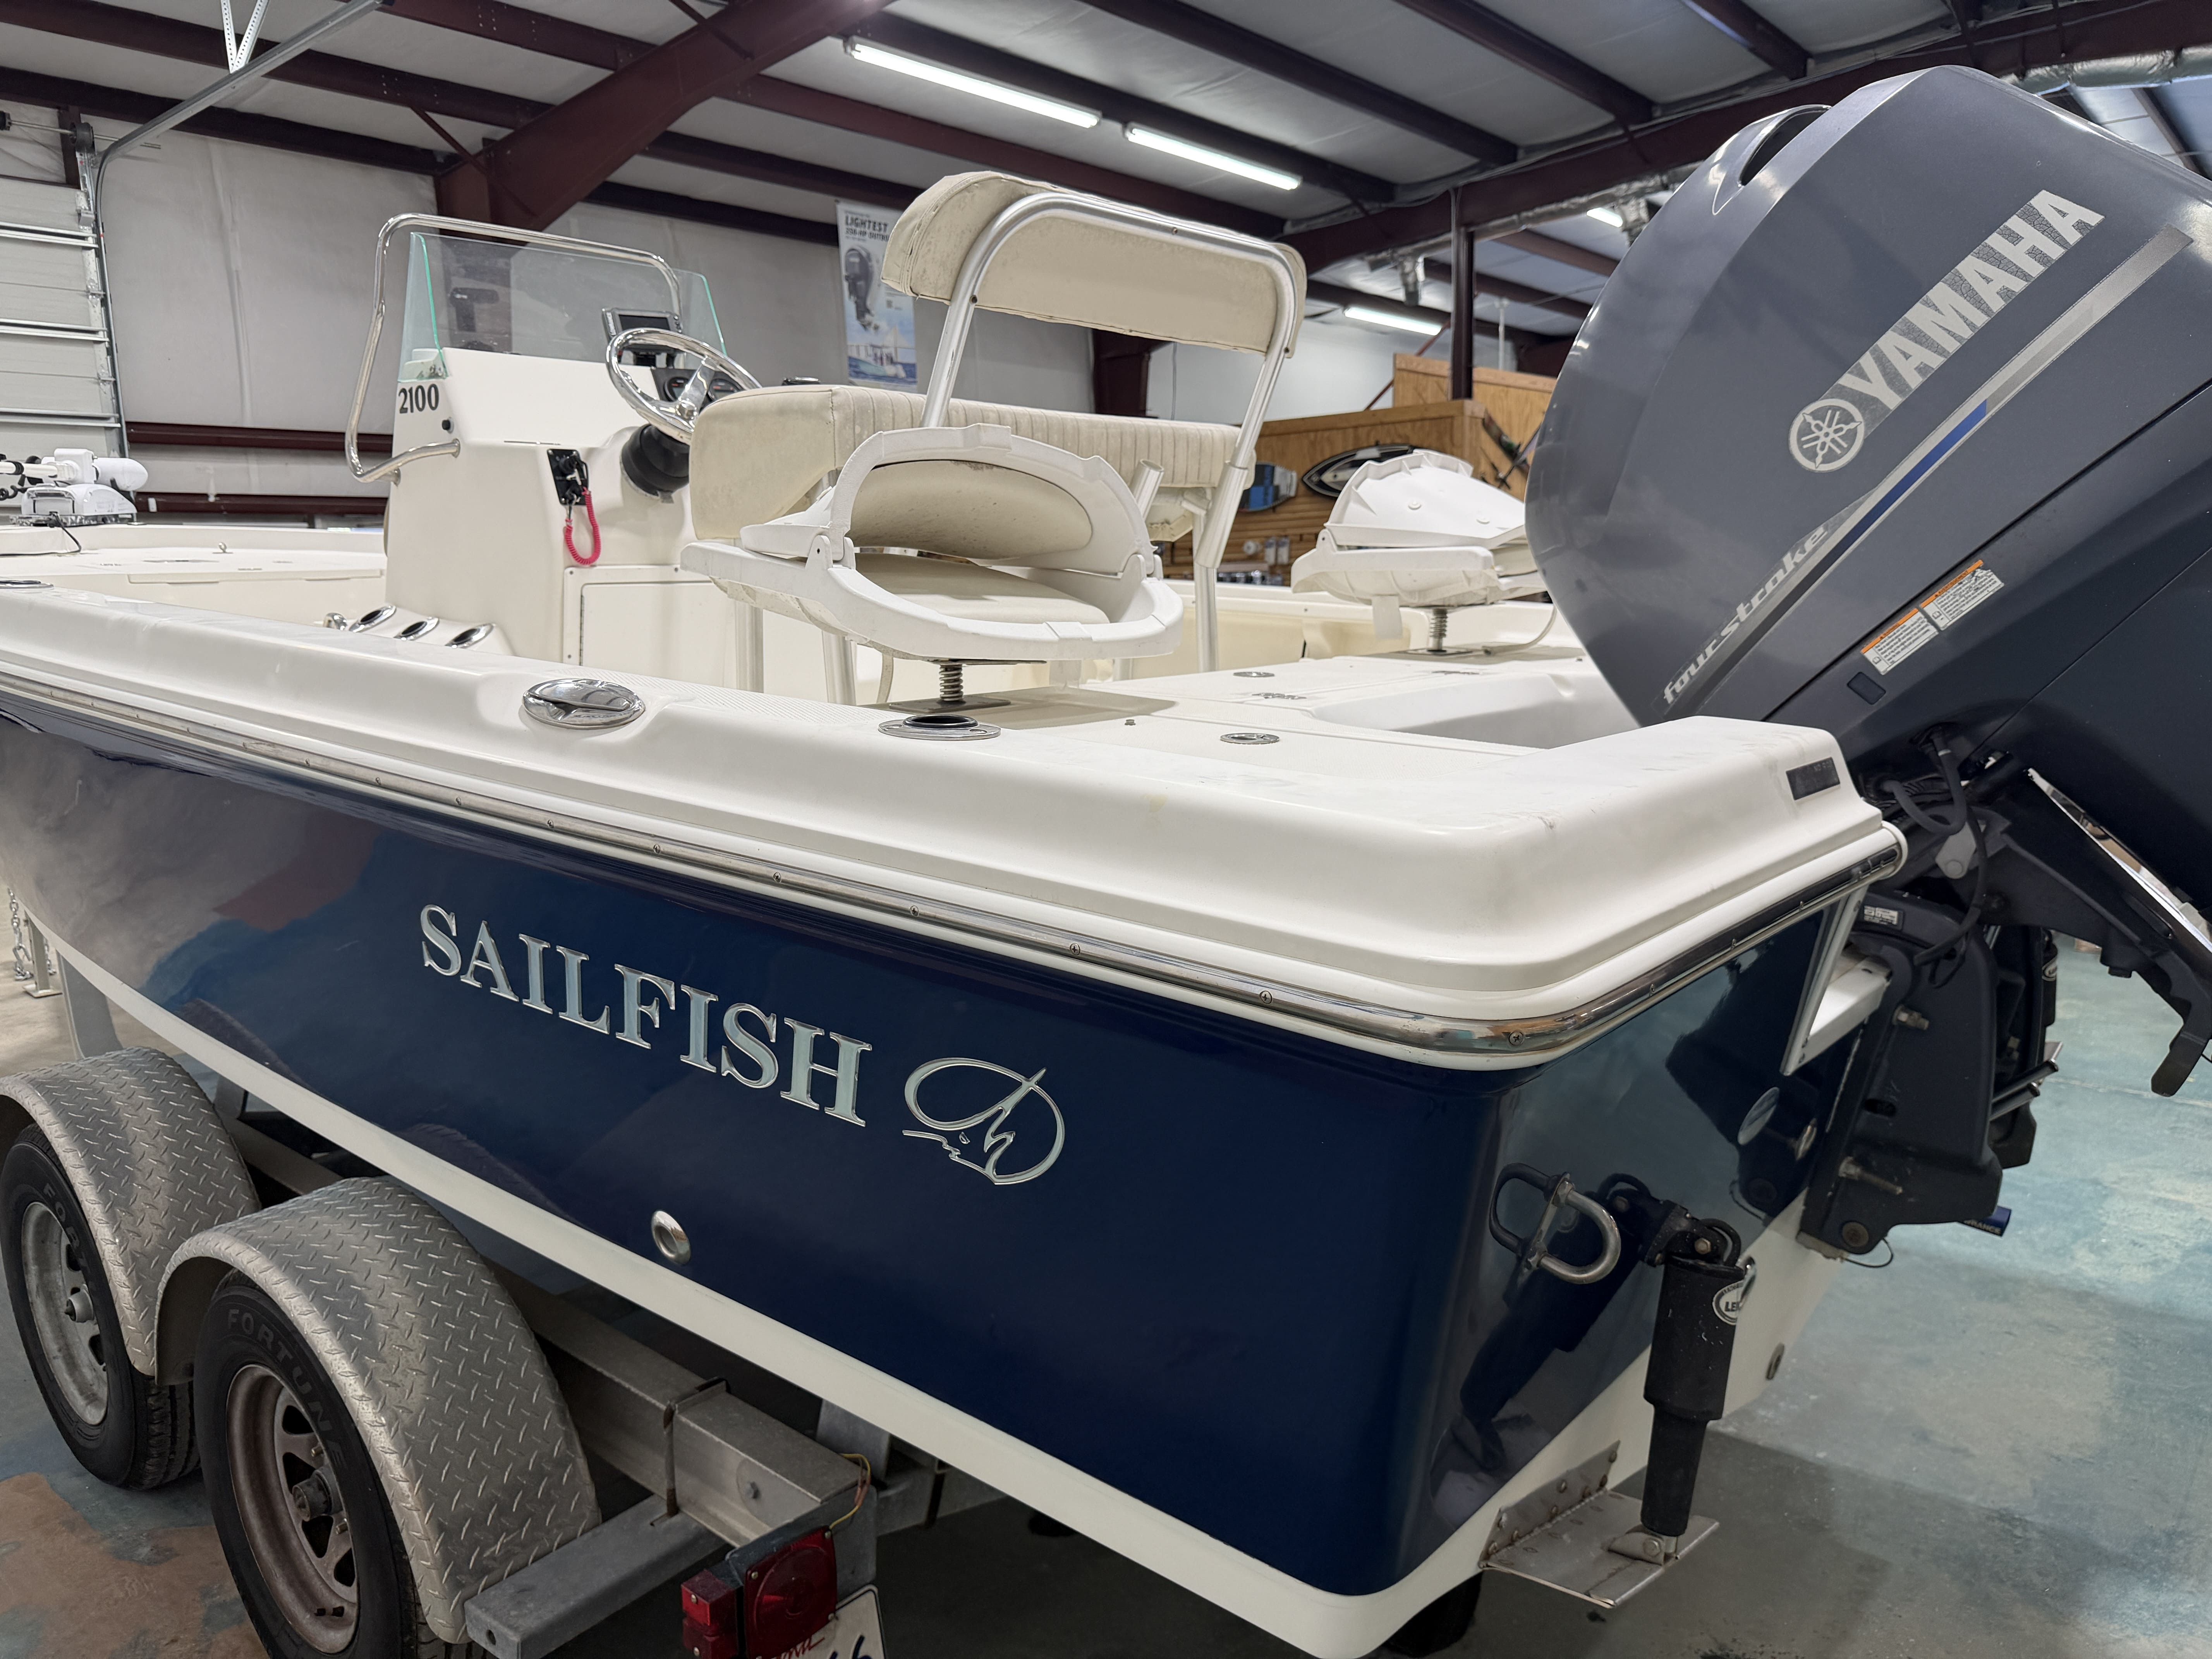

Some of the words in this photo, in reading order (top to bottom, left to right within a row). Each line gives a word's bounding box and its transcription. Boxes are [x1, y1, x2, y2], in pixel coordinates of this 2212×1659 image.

[845, 215, 888, 233] LIGHTEST
[1838, 190, 2105, 410] YAMAHA
[398, 383, 440, 414] 2100
[420, 904, 872, 1127] SAILFISH
